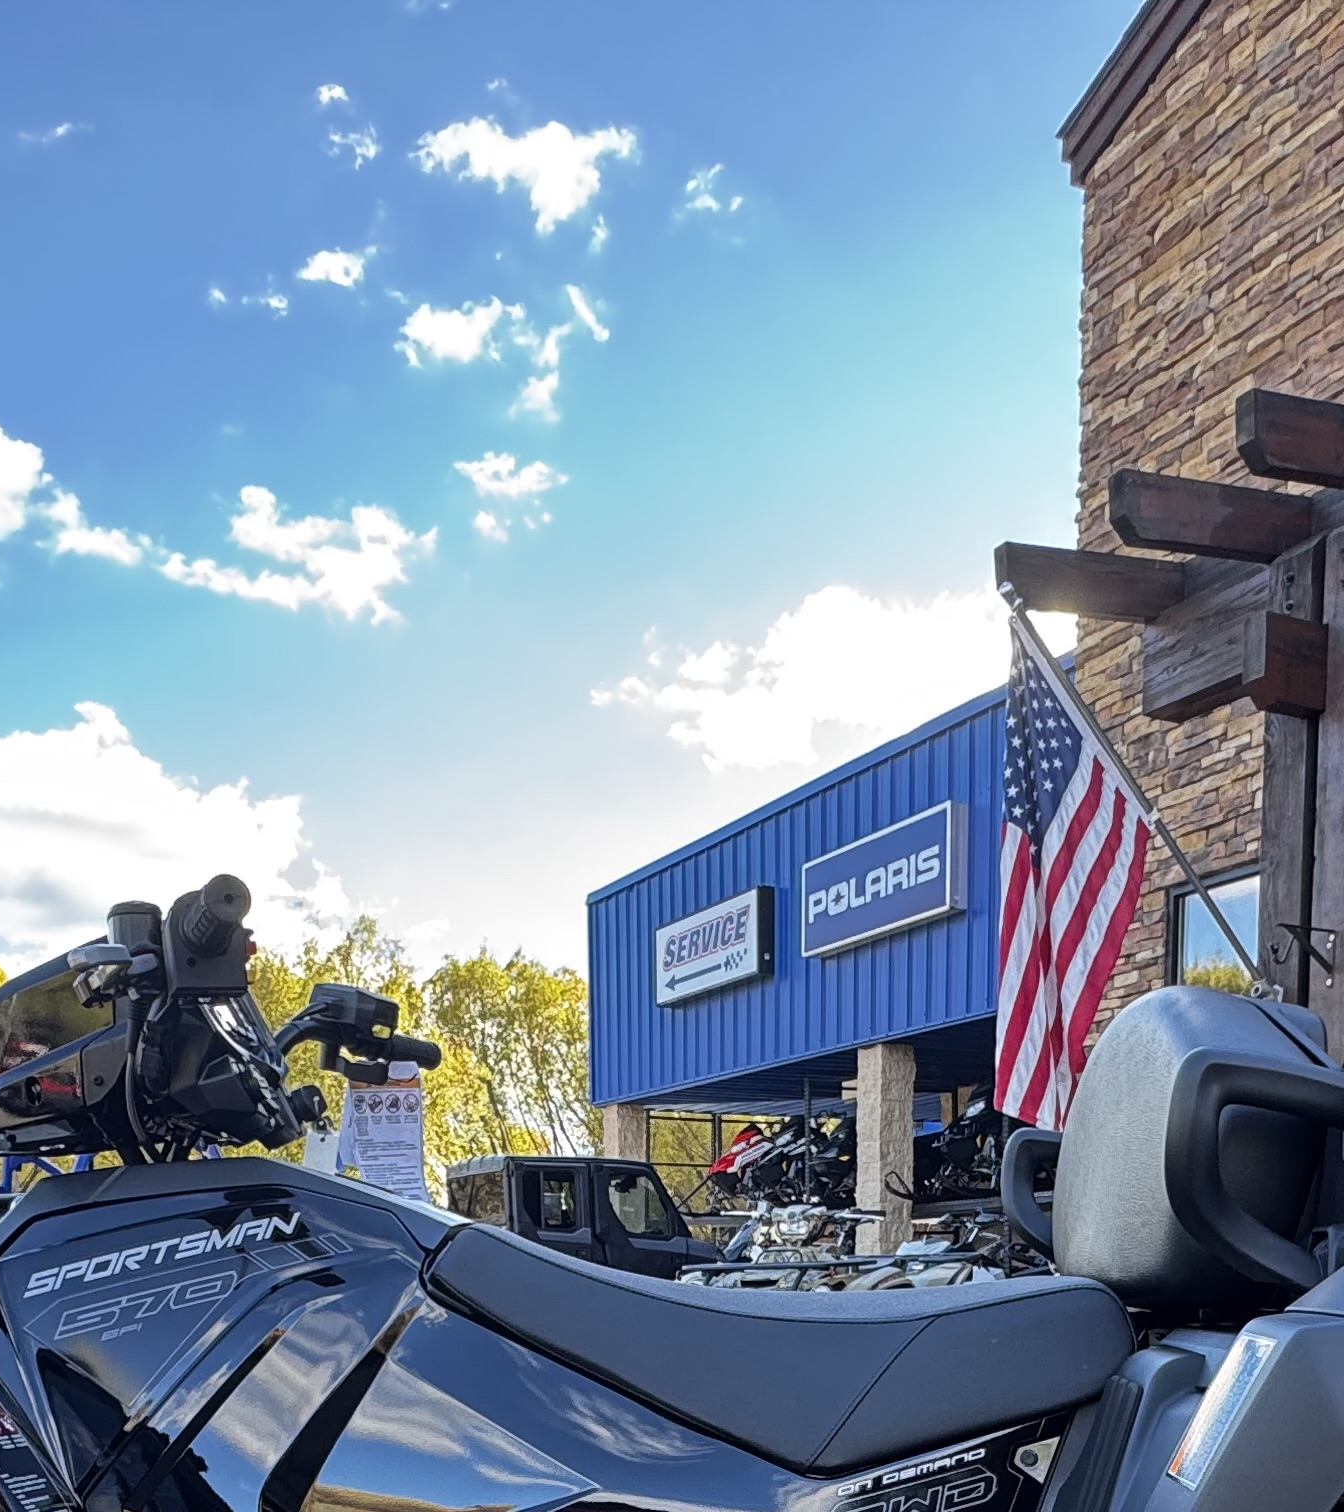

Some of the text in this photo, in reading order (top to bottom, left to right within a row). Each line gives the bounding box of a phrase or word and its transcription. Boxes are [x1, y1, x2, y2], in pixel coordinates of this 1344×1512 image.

[808, 845, 940, 924] POLARIS
[662, 904, 751, 971] SERVICE
[23, 1212, 301, 1299] SPORTSMAN
[54, 1270, 238, 1341] 570
[837, 1448, 987, 1497] ON DEMAND
